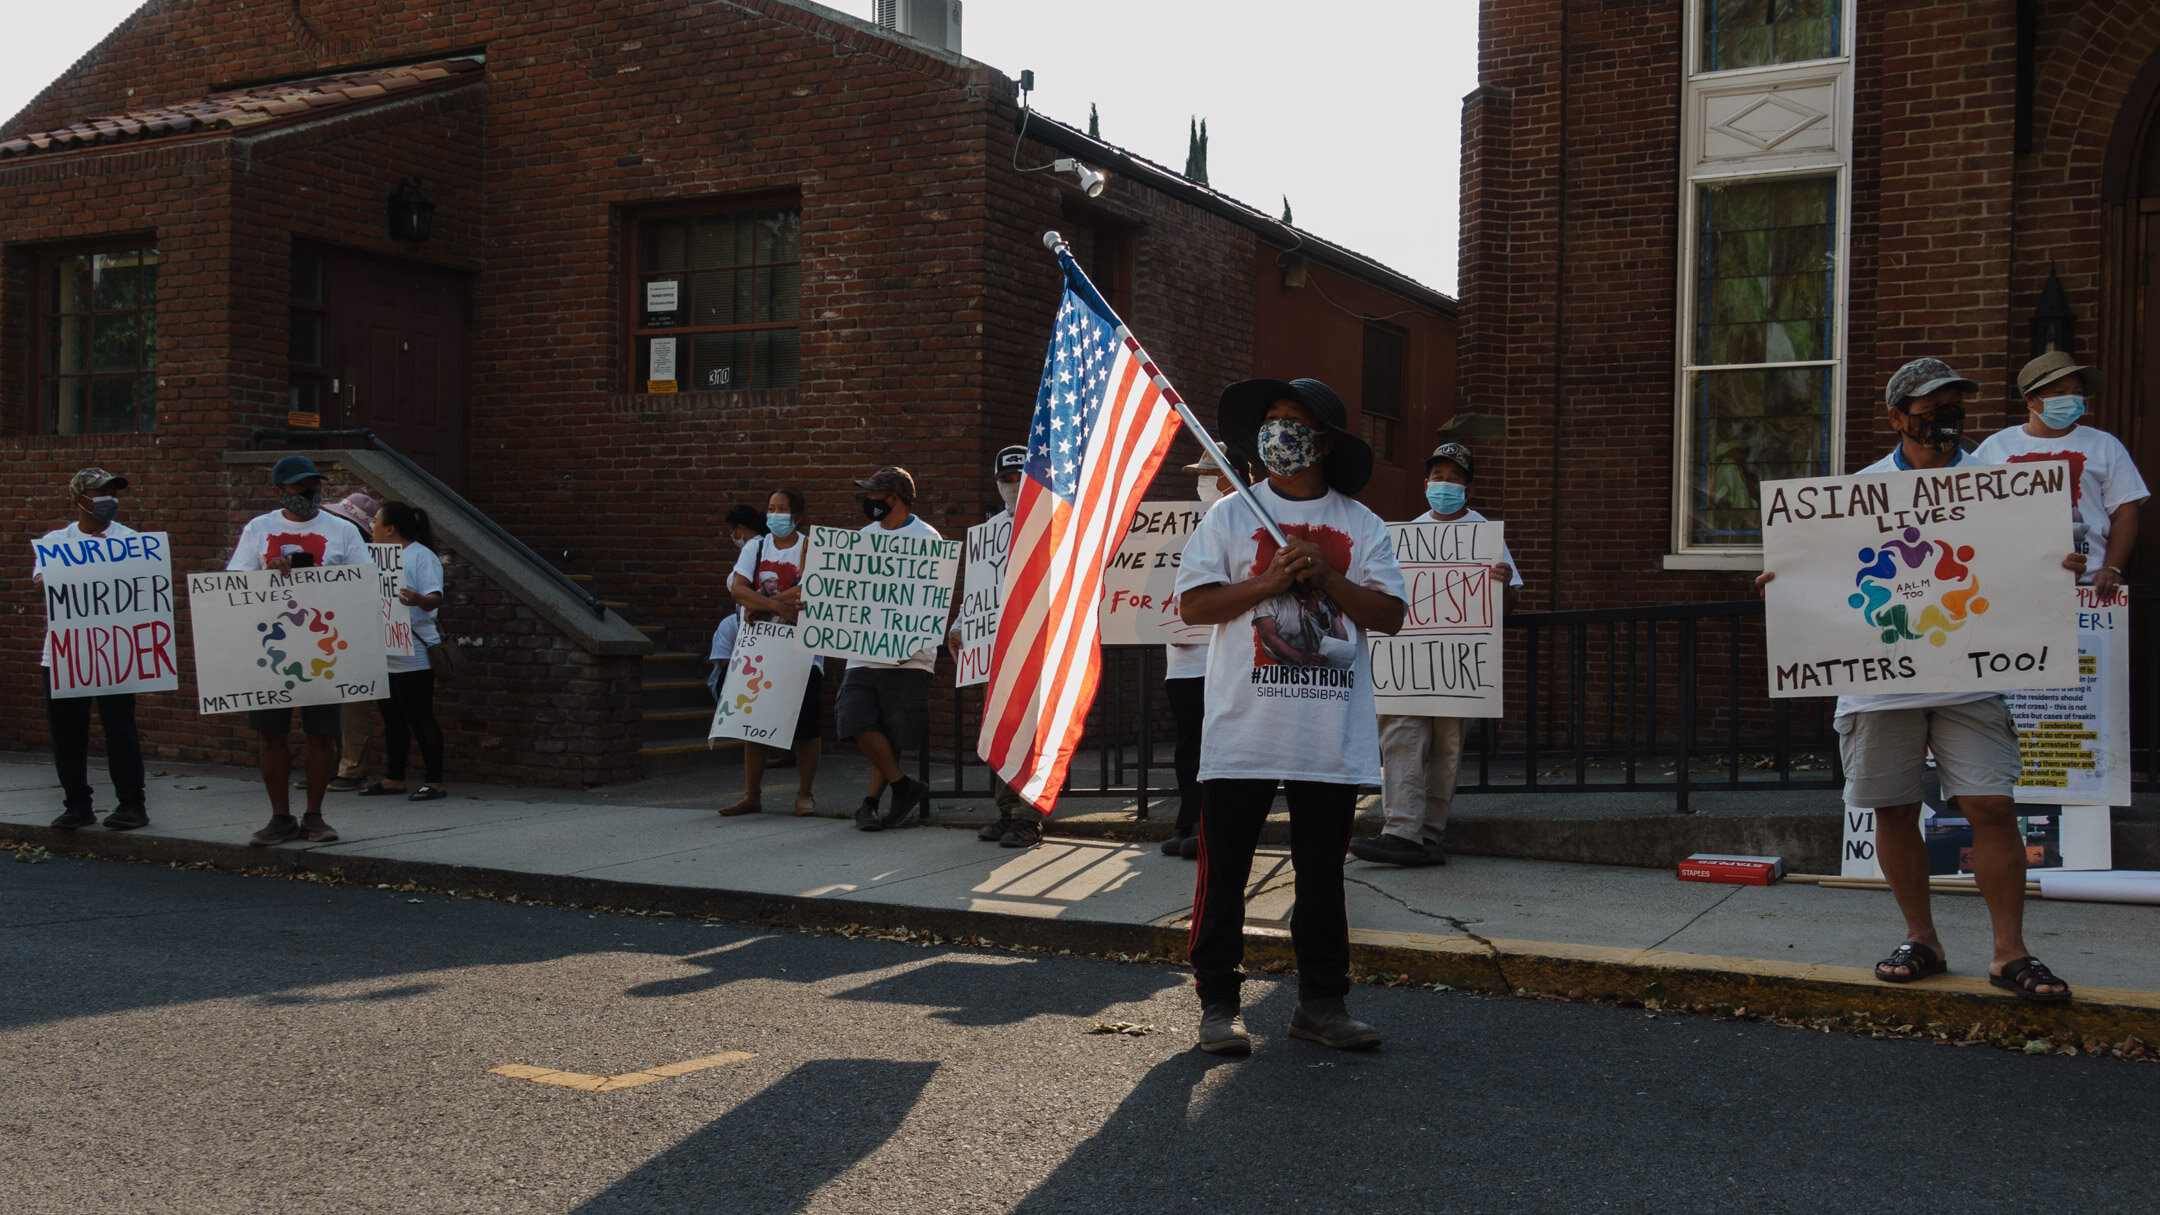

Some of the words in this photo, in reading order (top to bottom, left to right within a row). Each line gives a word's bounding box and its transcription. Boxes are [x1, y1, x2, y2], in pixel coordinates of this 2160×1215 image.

[710, 368, 729, 385] 310
[1767, 482, 1889, 526] ASIAN
[1912, 466, 2064, 509] AMERICAN
[1877, 506, 1966, 534] LIVES
[37, 535, 162, 567] MURDER
[814, 527, 861, 550] STOP
[870, 534, 959, 560] VIGILANTE
[969, 522, 1012, 564] WHO
[1392, 524, 1492, 561] ANCEL
[819, 552, 939, 580] INJUSTICE
[989, 555, 1007, 584] Y
[1106, 552, 1146, 569] NE
[1154, 552, 1182, 568] IS
[192, 575, 248, 594] ASIAN
[270, 567, 361, 588] AMERICAN
[806, 573, 915, 607] OVERTURN
[922, 585, 951, 609] THE
[1896, 580, 1931, 593] AALM
[48, 575, 171, 621] MURDER
[228, 589, 293, 607] LIVES
[963, 586, 1000, 617] CALL
[1110, 590, 1153, 614] FOR
[1408, 569, 1487, 626] CISM
[1902, 590, 1924, 600] TOO
[803, 601, 871, 625] WATER
[881, 608, 946, 635] TRUCK
[964, 612, 997, 642] THE
[2076, 612, 2114, 630] ER!
[50, 620, 177, 690] MURDER
[960, 644, 992, 683] MU
[1370, 640, 1494, 691] CULTURE
[1776, 656, 1917, 691] MATTERS
[1968, 646, 2048, 679] TOO!
[1251, 665, 1355, 689] #ZURGSTRONG
[203, 690, 292, 713] MATTERS
[336, 681, 375, 698] TOO!
[742, 725, 777, 739] TOO!
[2024, 760, 2041, 768] bring
[1848, 811, 1874, 833] VI
[1698, 860, 1763, 868] STAPLES
[1846, 840, 1874, 861] NO
[1681, 869, 1710, 878] STAPLES
